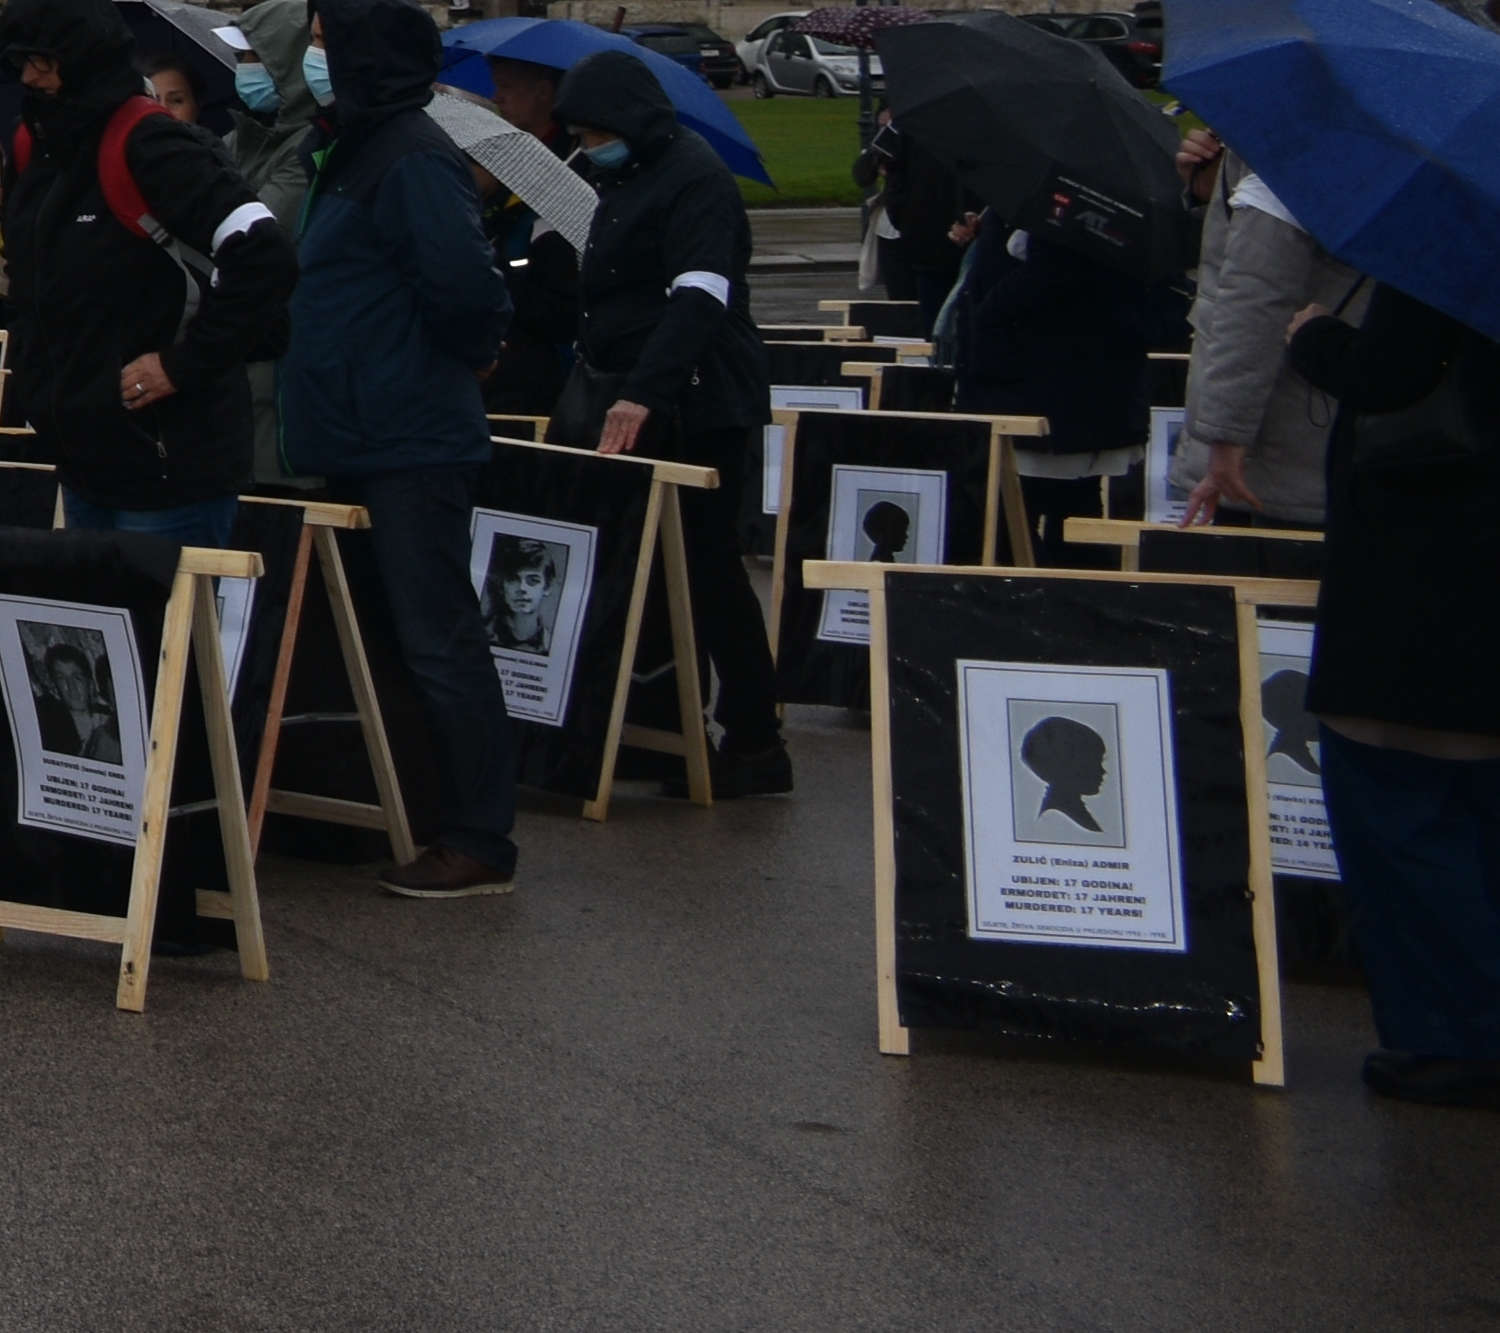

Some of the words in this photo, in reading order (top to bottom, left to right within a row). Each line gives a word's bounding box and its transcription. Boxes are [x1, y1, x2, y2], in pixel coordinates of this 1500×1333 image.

[46, 774, 78, 787] UBIJEN:
[80, 781, 89, 789] 17
[91, 784, 125, 797] GODINA!
[40, 784, 86, 799] ERMORDET:
[88, 794, 96, 802] 17
[99, 796, 134, 810] JAHREN!
[43, 796, 89, 812] MURDERED:
[91, 806, 101, 814] 17
[102, 809, 132, 821] YEARS!
[1300, 816, 1327, 826] GODI
[1012, 854, 1047, 865] ZULIĆ
[1050, 857, 1089, 869] (Eniza)
[1092, 860, 1130, 870] ADMIR
[1011, 875, 1060, 887] UBIJEN:
[1064, 879, 1078, 887] 17
[1081, 880, 1133, 891] GODINA!
[1001, 888, 1071, 900] ERMORDET:
[1075, 893, 1088, 901] 17
[1092, 894, 1146, 905] JAHREN!
[1005, 901, 1077, 914] MURDERED:
[1080, 906, 1093, 915] 17
[1098, 907, 1143, 918] YEARS!
